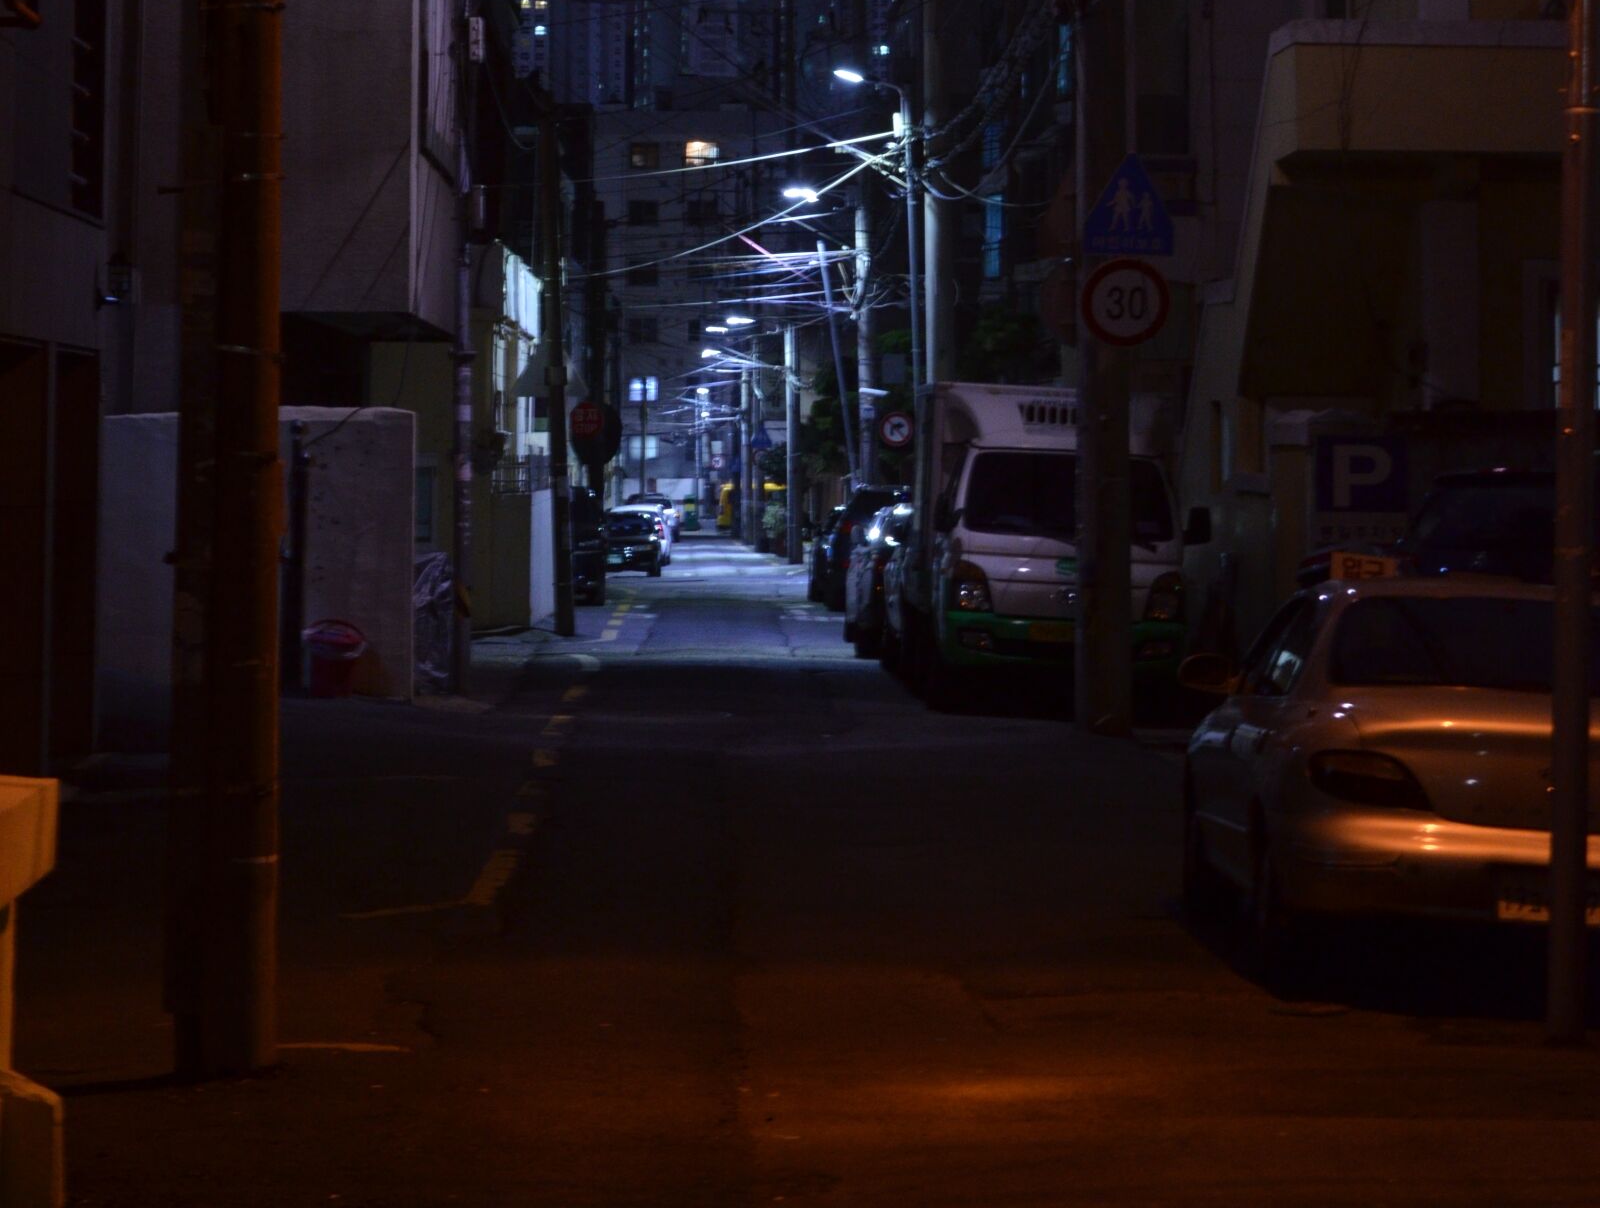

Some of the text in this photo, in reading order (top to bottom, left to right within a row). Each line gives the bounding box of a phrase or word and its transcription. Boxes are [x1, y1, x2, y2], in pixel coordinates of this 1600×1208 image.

[1106, 286, 1146, 320] 30
[1332, 444, 1393, 507] P
[1343, 557, 1384, 579] 입구
